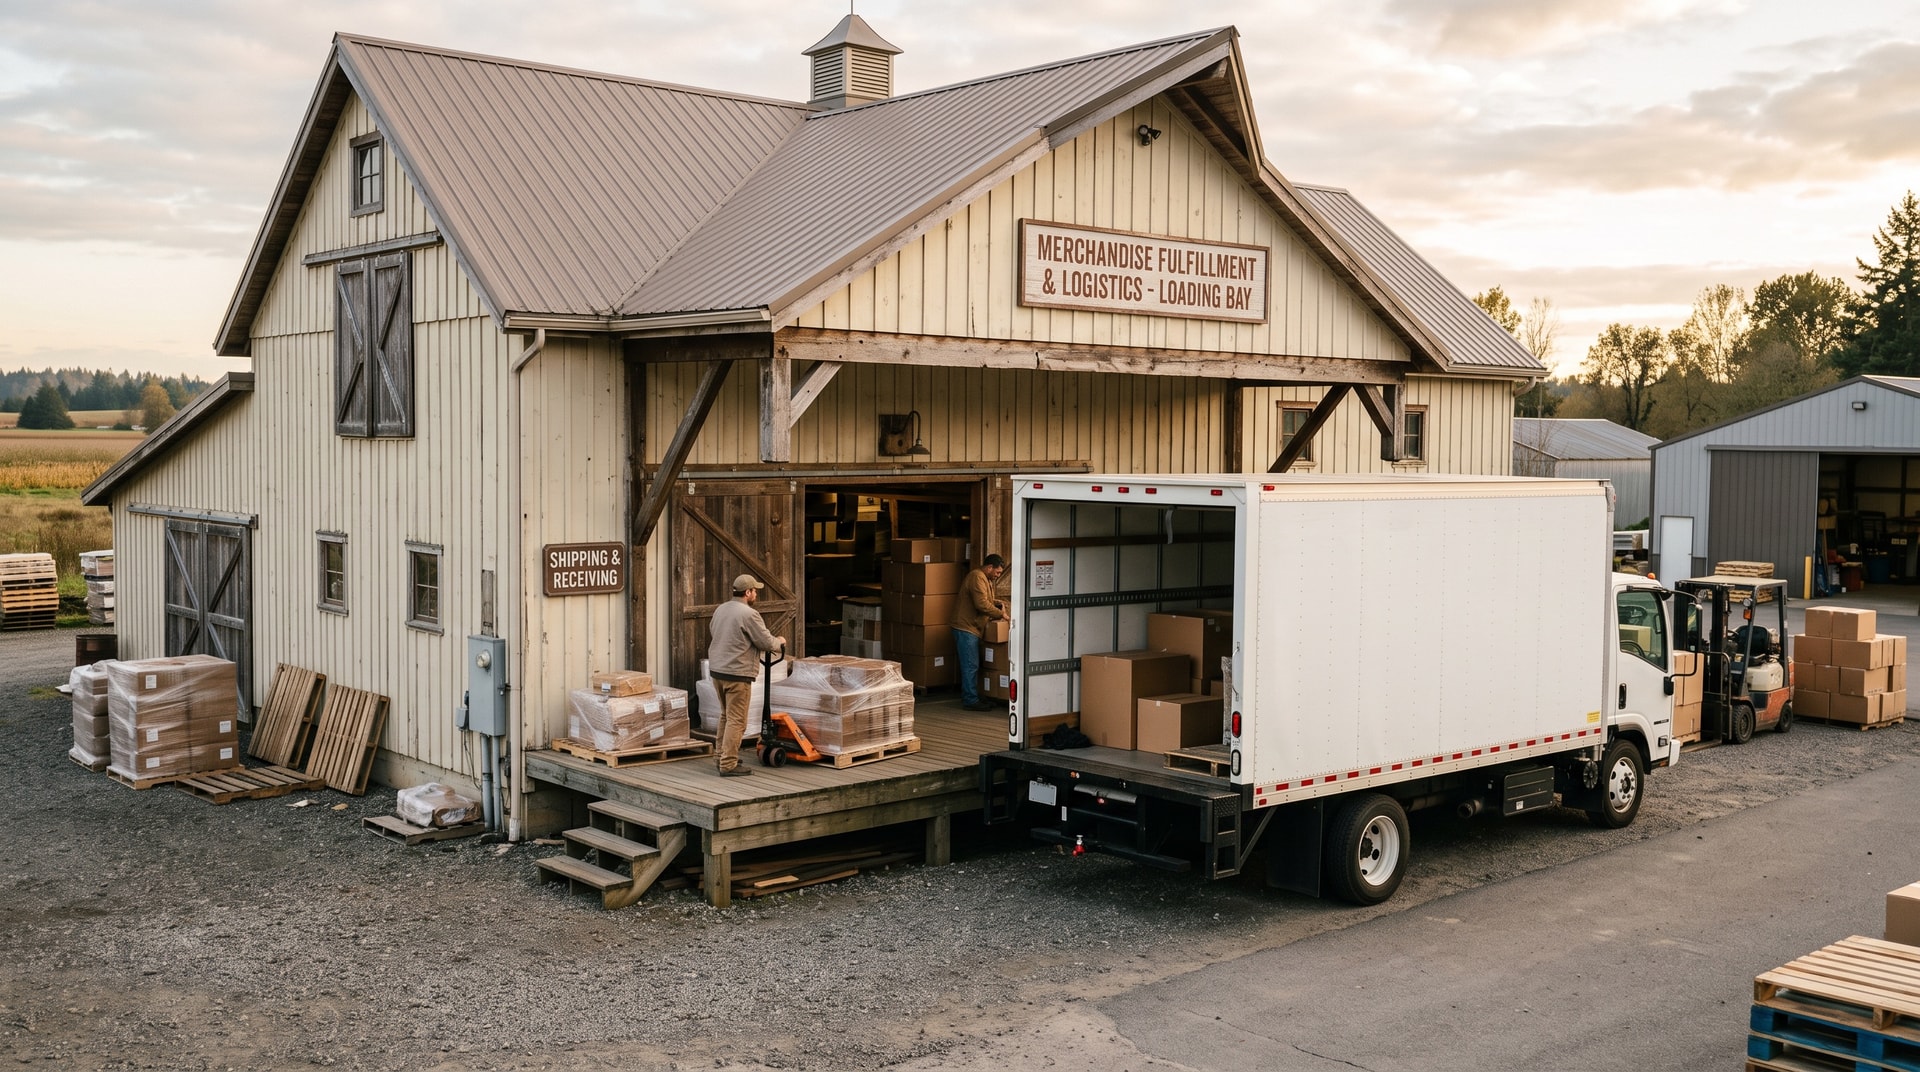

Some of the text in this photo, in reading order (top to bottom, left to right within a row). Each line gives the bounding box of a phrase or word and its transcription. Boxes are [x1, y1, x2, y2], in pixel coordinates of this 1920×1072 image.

[1038, 234, 1257, 281] MERCHANDISE FULFILLMENT
[1042, 268, 1056, 295] &
[1062, 269, 1143, 302] LOGISTICS
[1159, 279, 1221, 307] LOADING
[1226, 286, 1252, 310] BAY
[550, 549, 621, 568] SHIPPING &
[553, 569, 618, 588] RECEIVING
